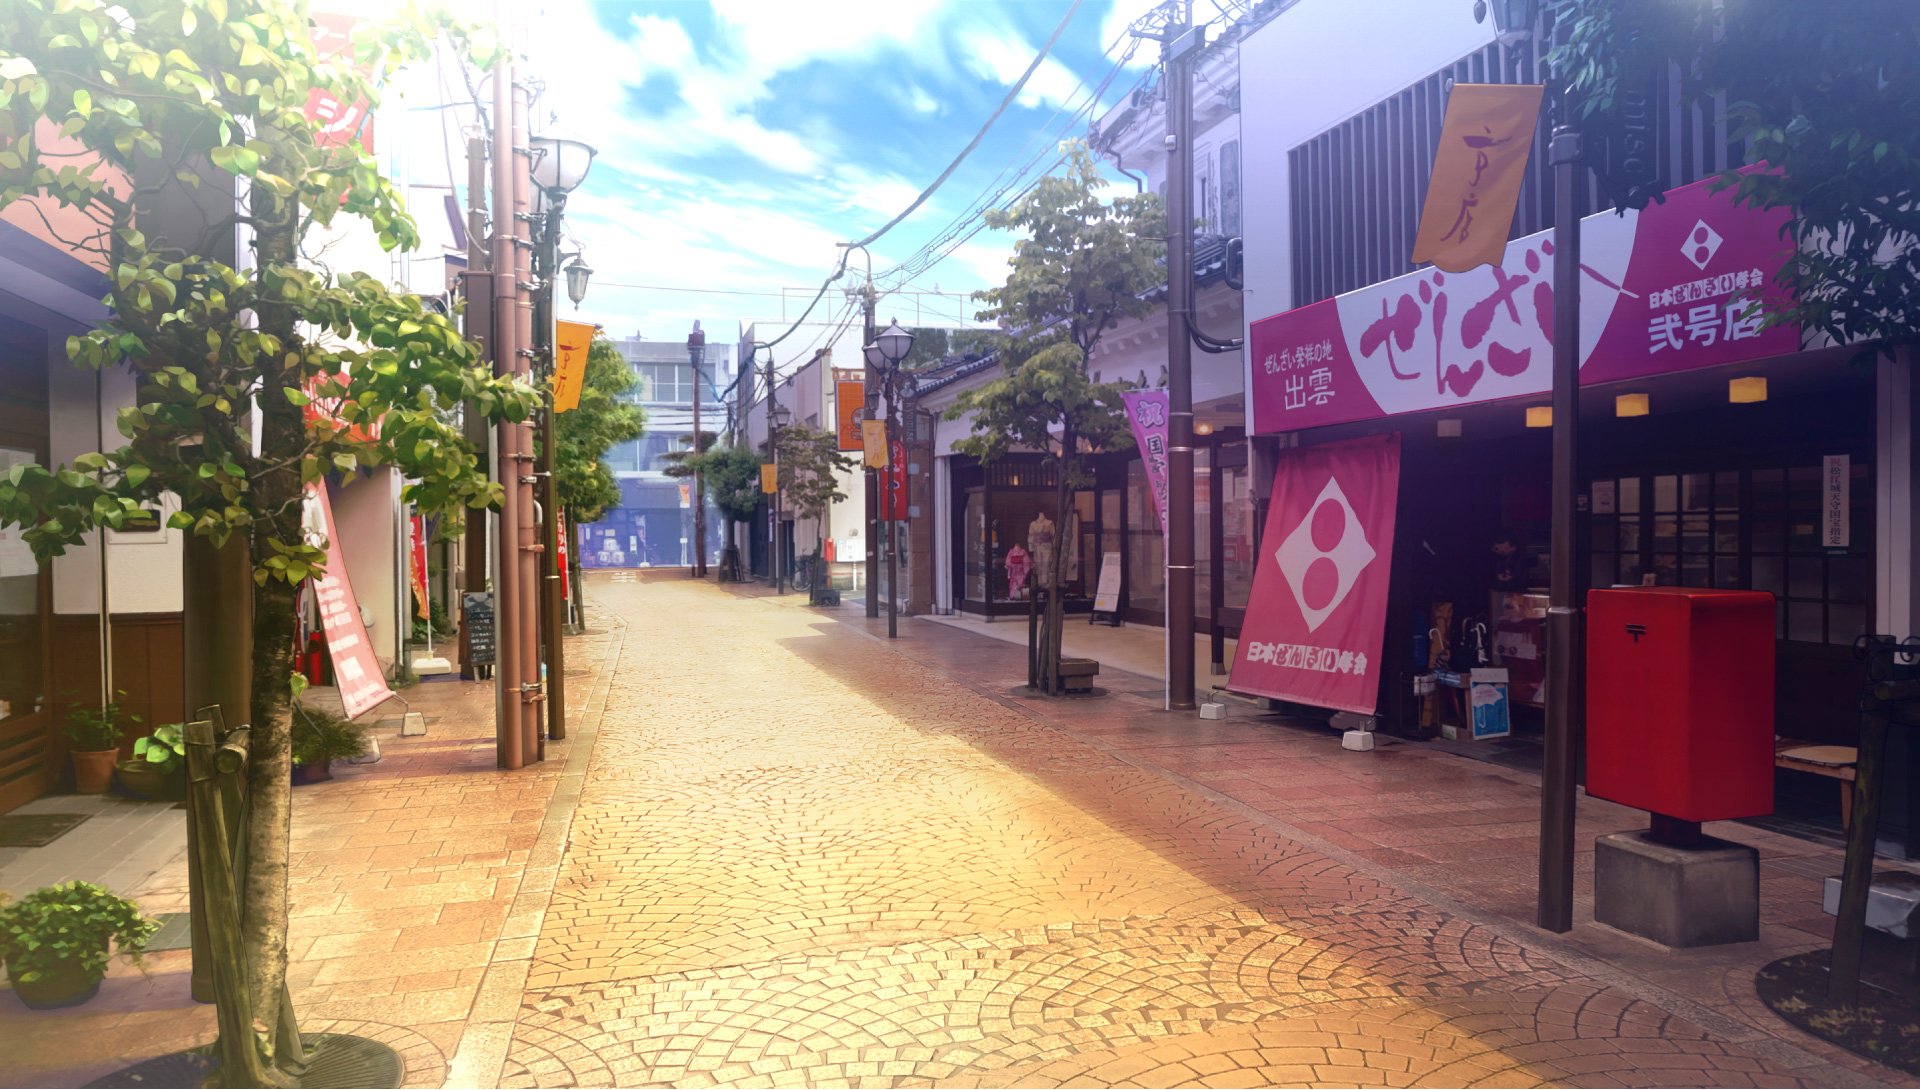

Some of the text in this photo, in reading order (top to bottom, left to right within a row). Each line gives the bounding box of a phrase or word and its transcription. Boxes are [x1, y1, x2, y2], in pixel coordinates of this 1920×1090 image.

[1647, 298, 1764, 354] 弐号店
[1264, 339, 1333, 374] ぜんざい発祥の地
[1285, 367, 1335, 410] 出雲
